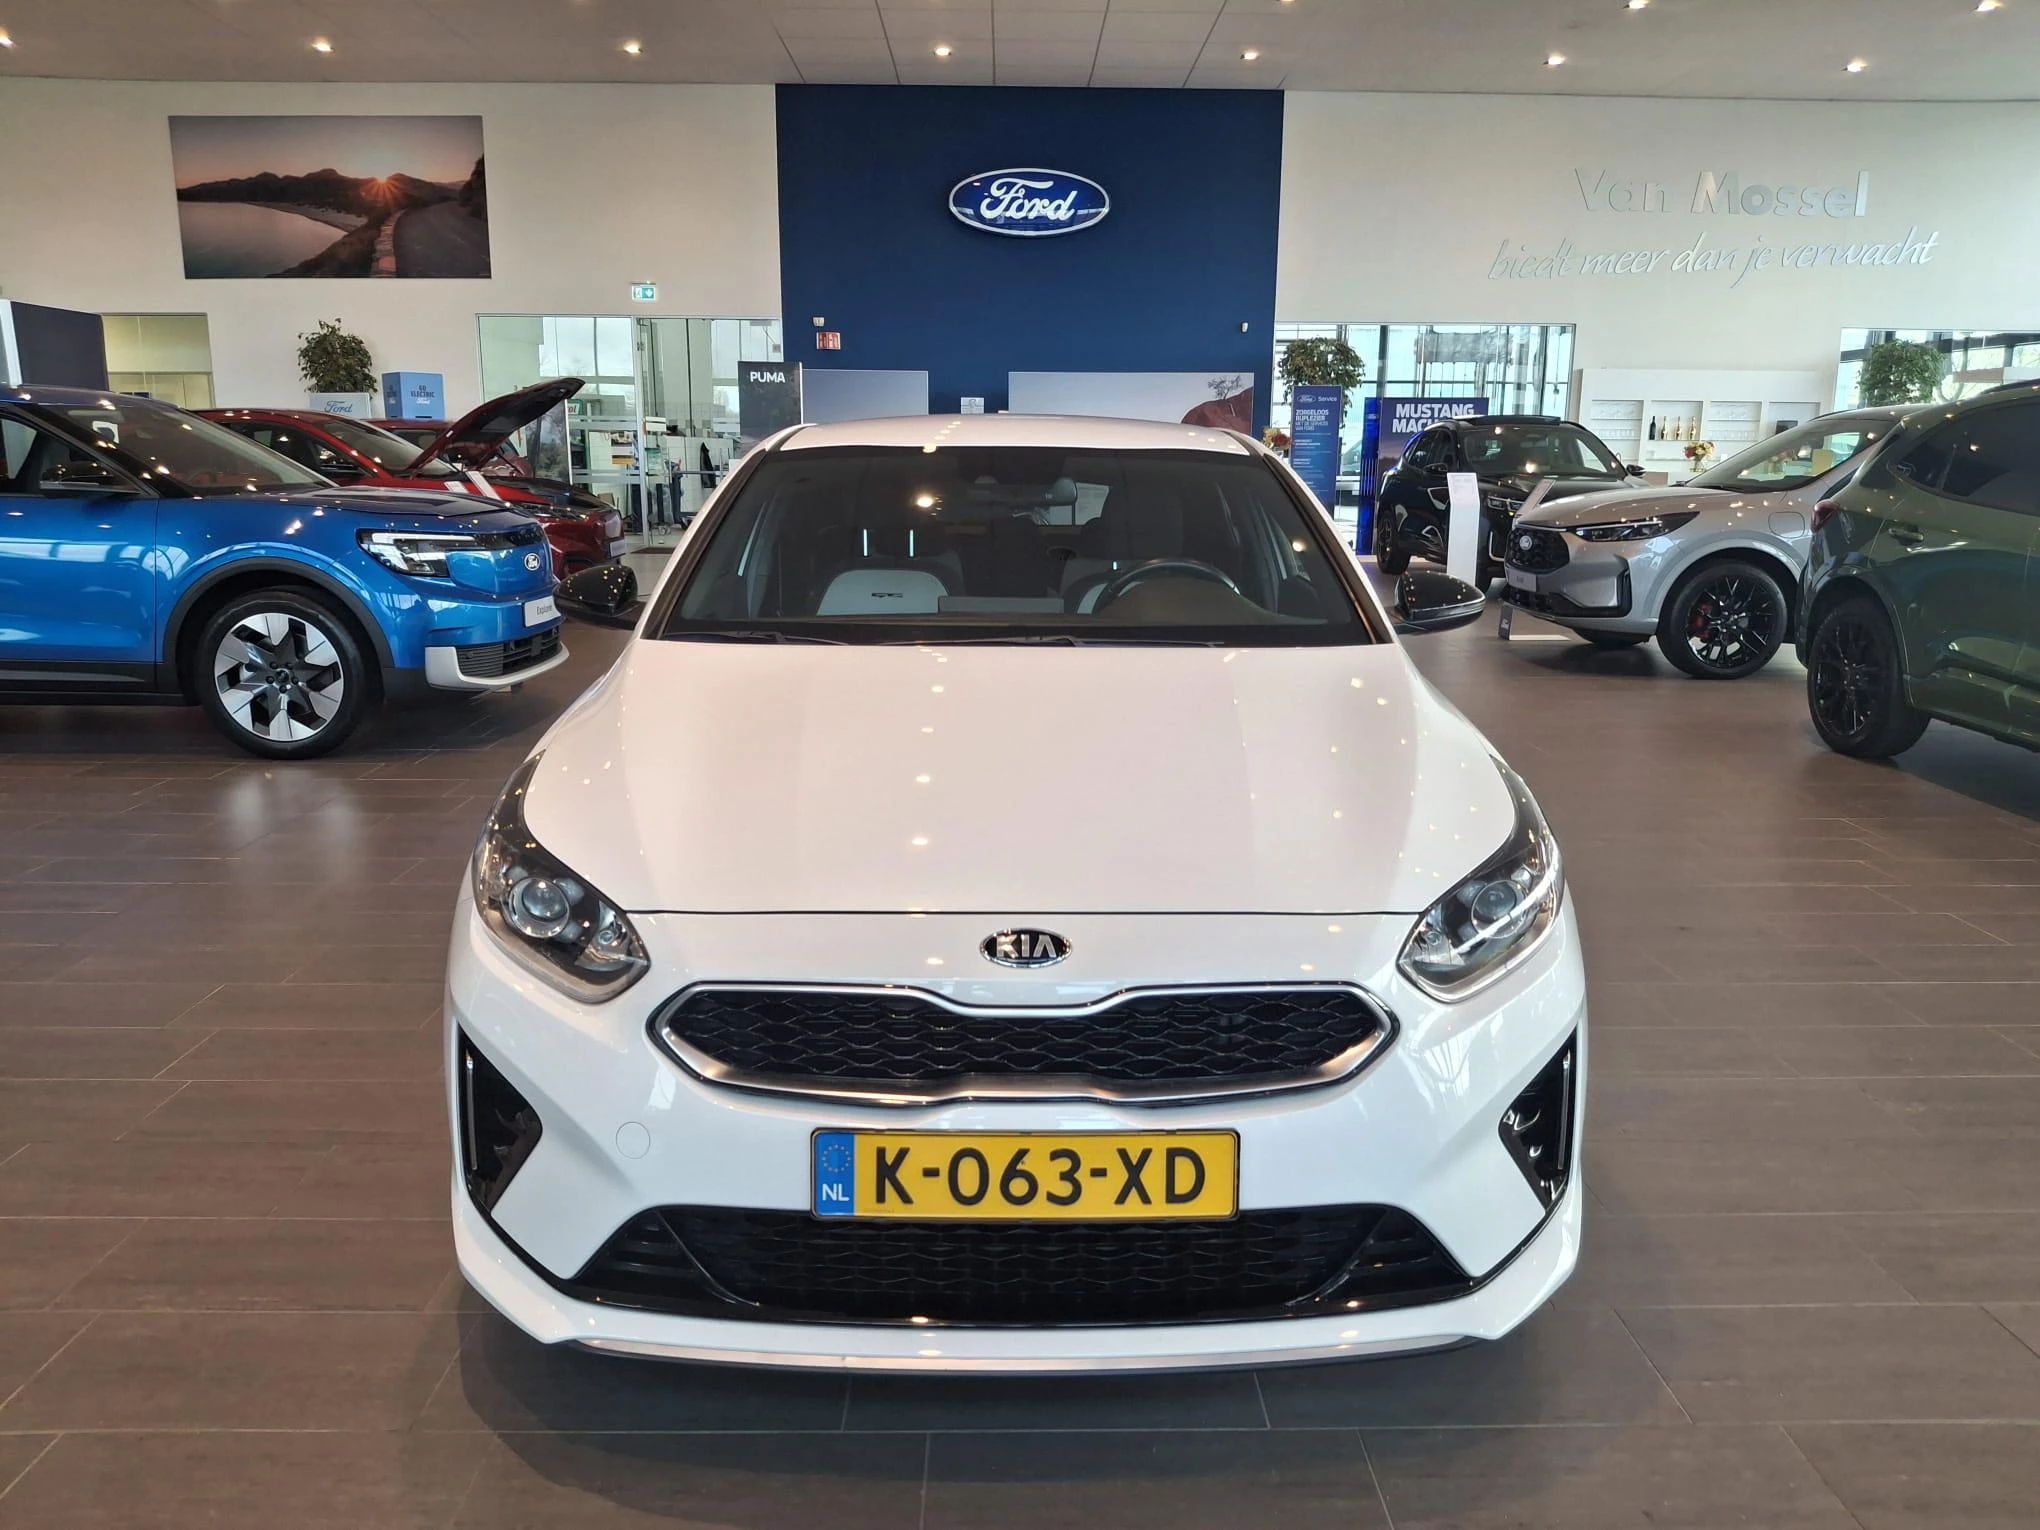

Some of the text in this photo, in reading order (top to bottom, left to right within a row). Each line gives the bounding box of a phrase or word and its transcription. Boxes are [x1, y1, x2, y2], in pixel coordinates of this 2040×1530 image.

[980, 178, 1077, 220] Ford
[1574, 167, 1869, 218] Van Mossel
[1487, 225, 1940, 289] biedt meer dan je verwacht
[750, 371, 786, 383] PUMA
[323, 400, 353, 414] Ford
[1395, 403, 1475, 418] MUSTANG
[996, 934, 1057, 958] KIA
[875, 1145, 1206, 1205] K-063-XD
[822, 1183, 850, 1201] NL
